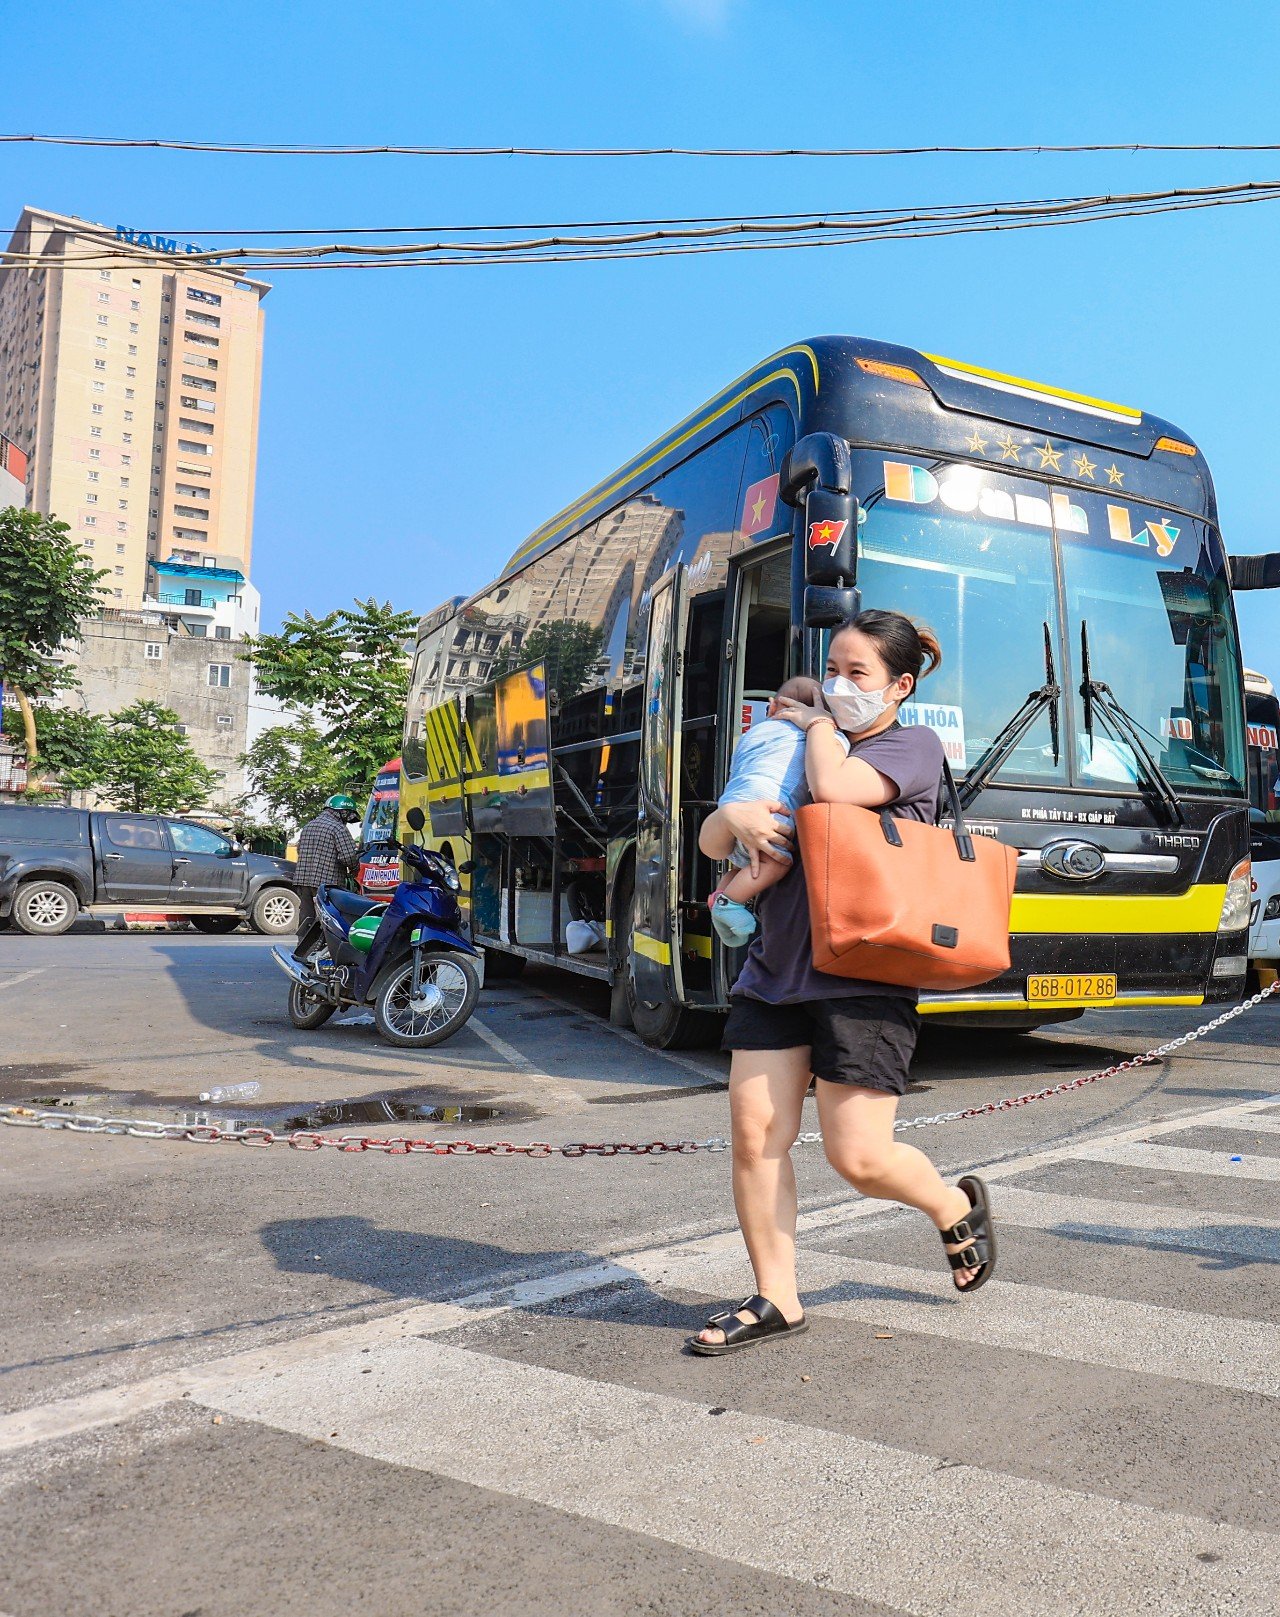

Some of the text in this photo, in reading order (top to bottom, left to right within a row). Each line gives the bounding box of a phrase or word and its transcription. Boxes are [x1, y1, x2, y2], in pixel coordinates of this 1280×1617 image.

[116, 224, 177, 255] NAM
[1107, 504, 1181, 556] Lý
[924, 707, 958, 728] HÓA
[1247, 724, 1276, 750] NỘI
[1021, 808, 1031, 818] BX
[1048, 807, 1061, 820] TÂY
[1078, 812, 1087, 823] BX
[1088, 811, 1102, 823] GIÁP
[1103, 811, 1115, 824] BÁT
